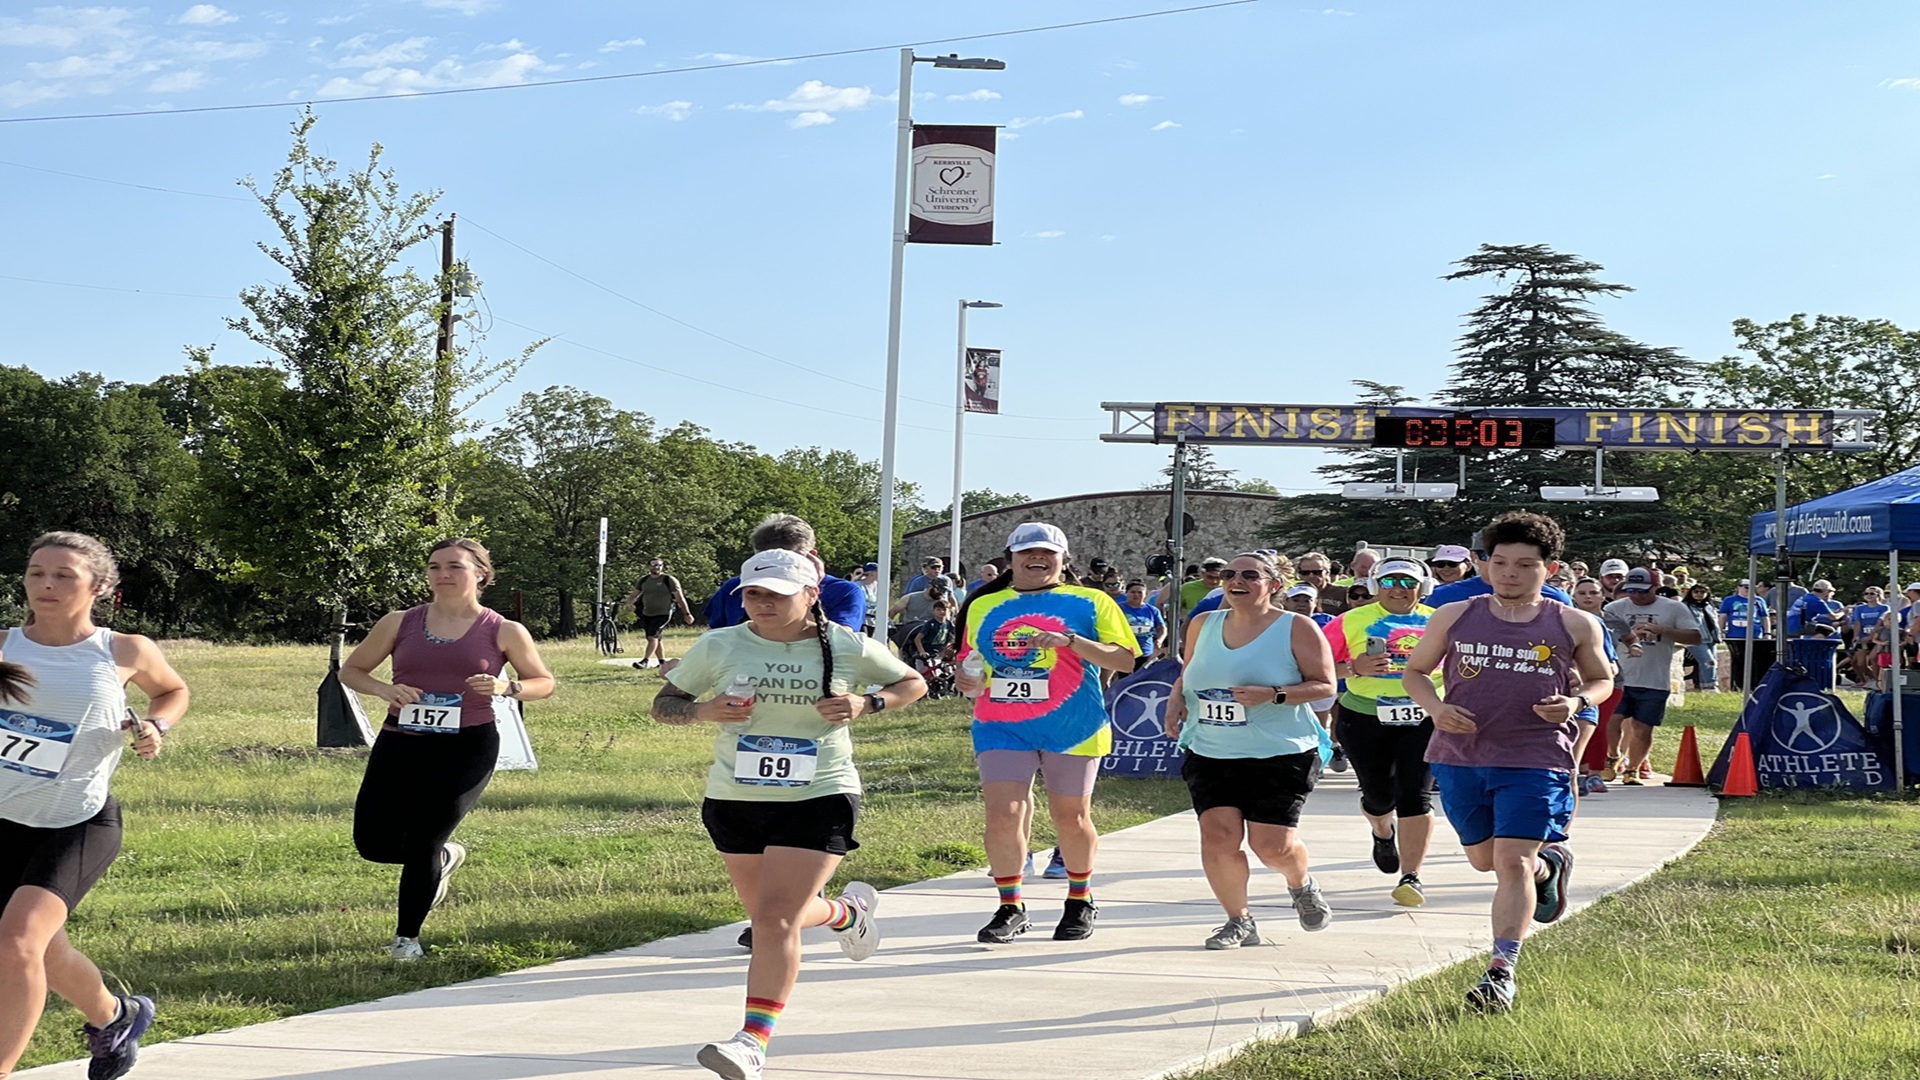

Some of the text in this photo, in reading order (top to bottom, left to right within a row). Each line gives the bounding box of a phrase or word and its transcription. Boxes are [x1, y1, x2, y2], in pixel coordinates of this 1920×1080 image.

[928, 187, 978, 195] Schreiner
[925, 194, 979, 207] University
[1163, 405, 1391, 441] FINISH
[1585, 411, 1824, 445] FINISH
[1764, 510, 1873, 539] ww.ahleteguild.com
[1454, 641, 1540, 661] Fun in the sun
[764, 662, 803, 674] YOU
[1495, 659, 1511, 669] in
[1513, 661, 1536, 673] the
[749, 676, 818, 690] CAN DO
[1006, 682, 1032, 698] 29
[757, 692, 825, 706] YTHIN
[411, 708, 449, 726] 157
[1206, 703, 1235, 721] 115
[1389, 707, 1424, 721] 135
[1, 735, 41, 762] 77
[1111, 740, 1181, 758] HLET
[758, 756, 791, 778] 69
[1103, 757, 1168, 772] UIL
[1757, 752, 1881, 773] ATHLETE
